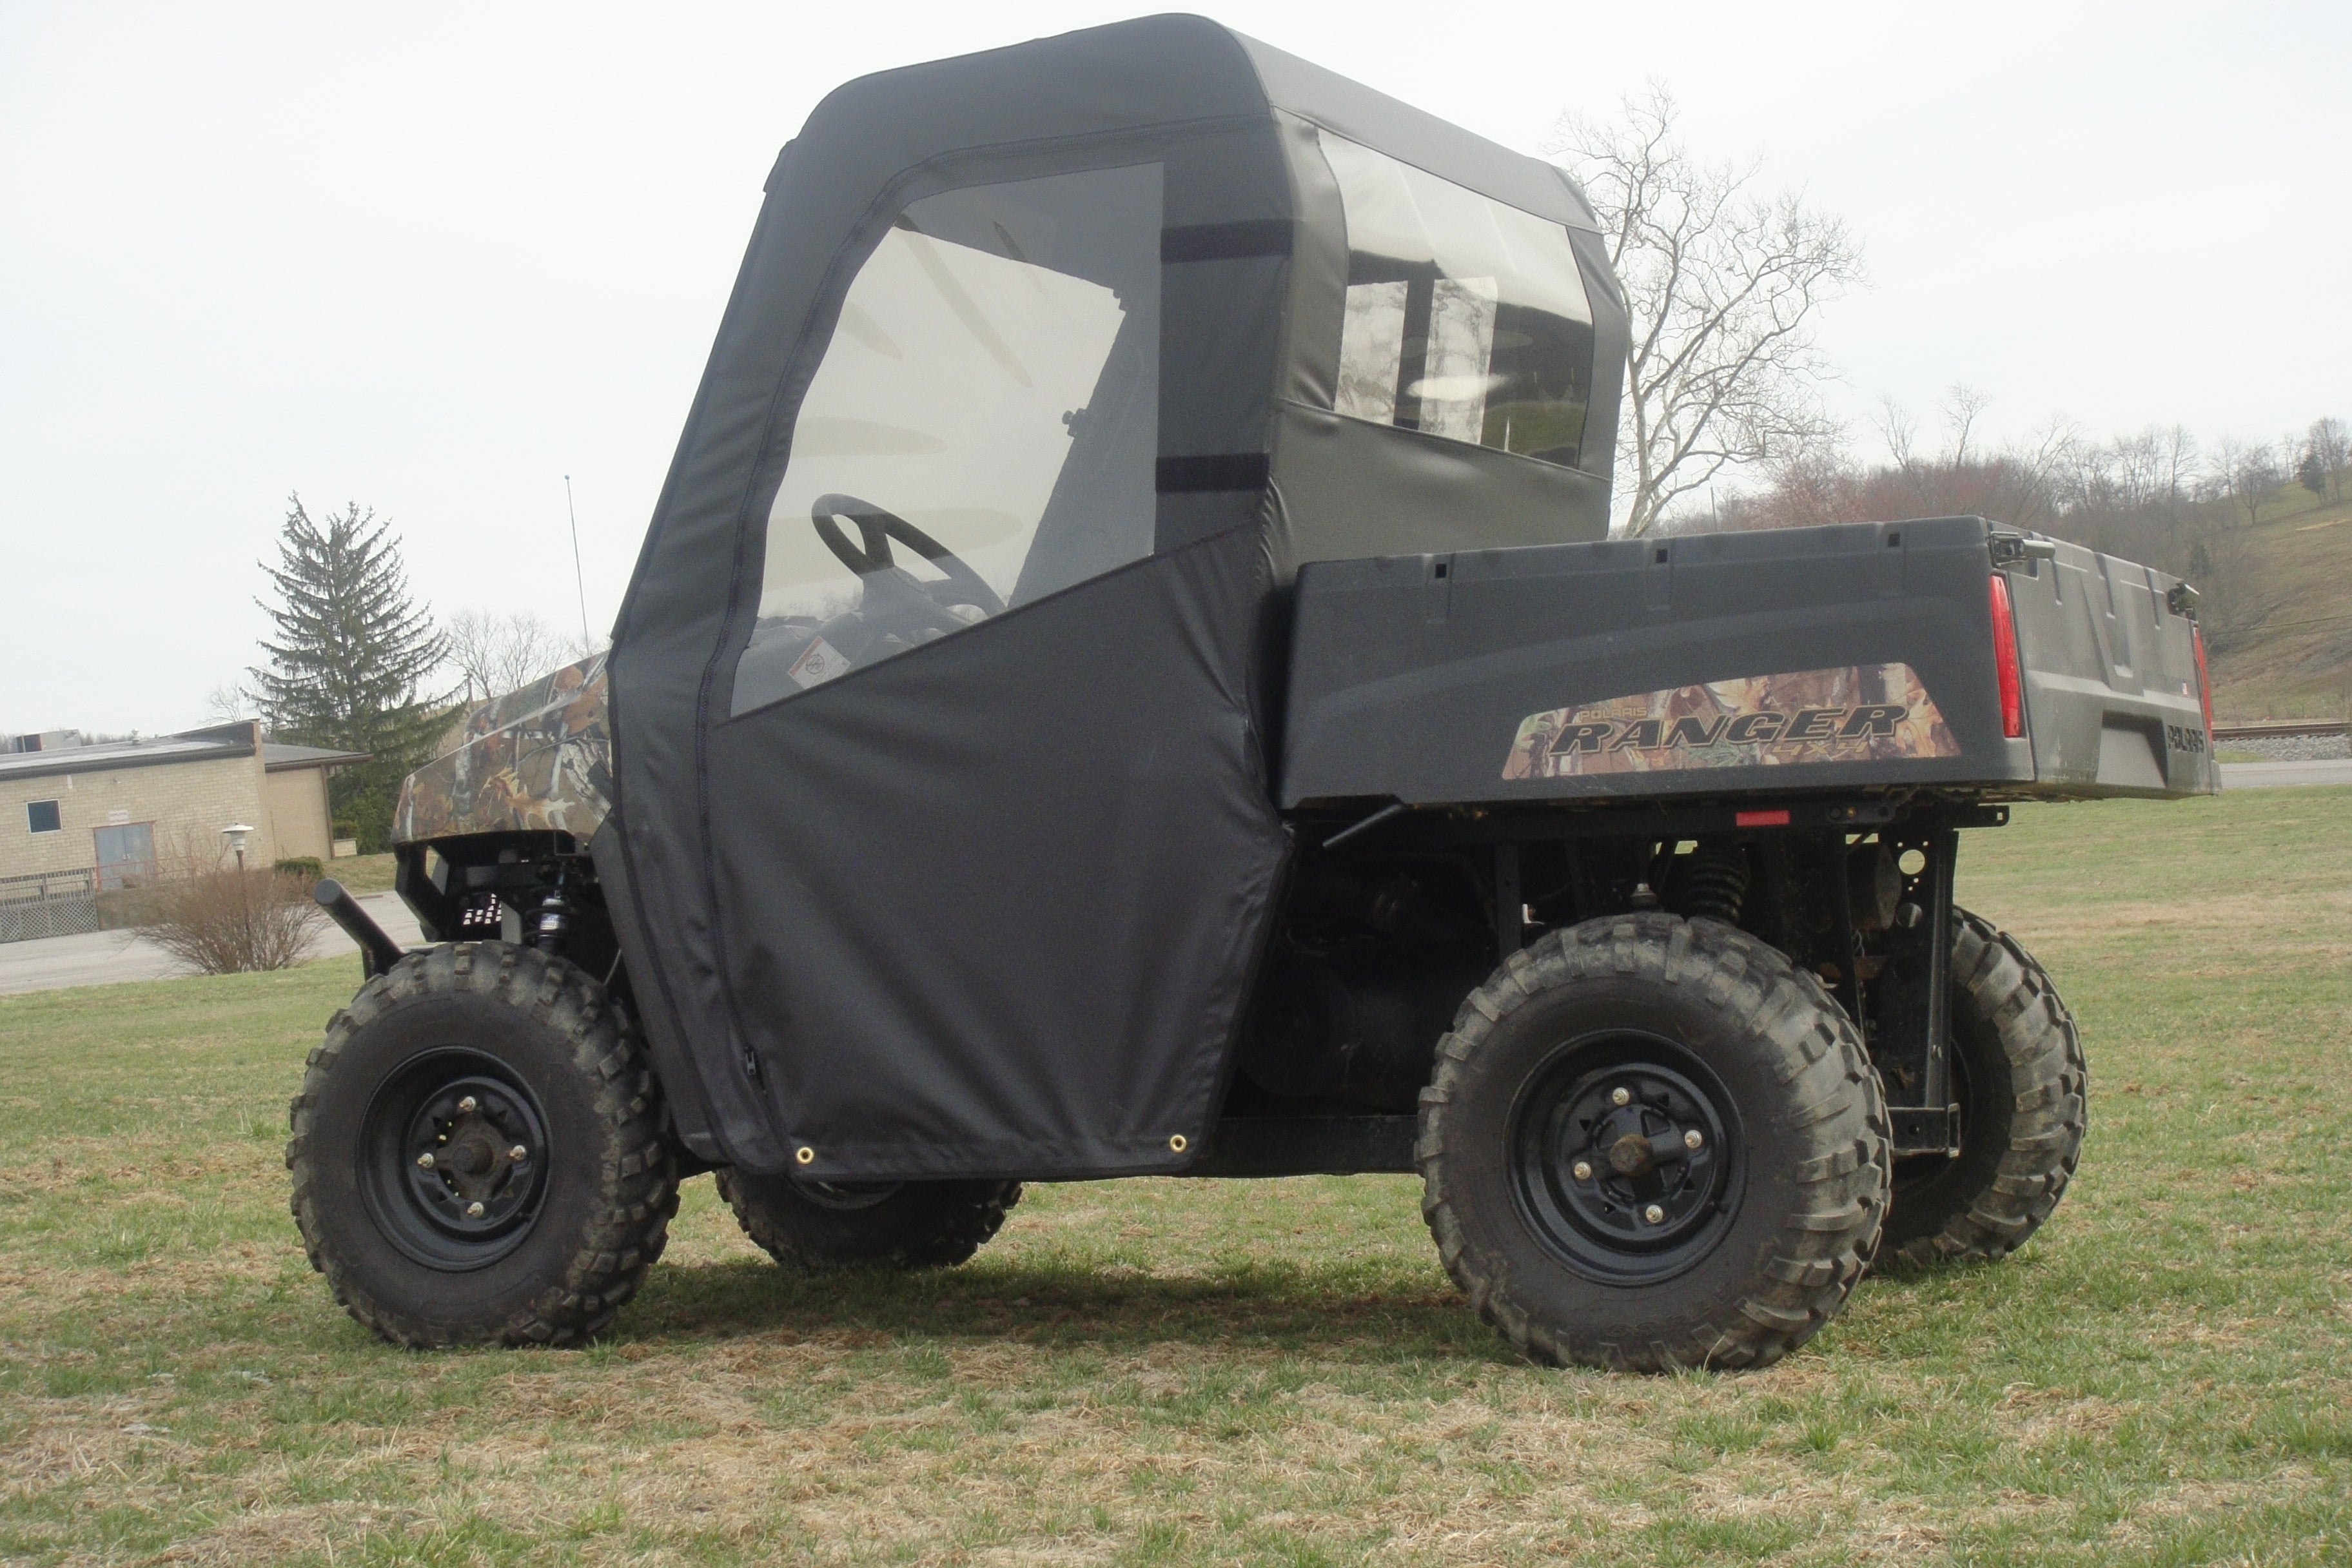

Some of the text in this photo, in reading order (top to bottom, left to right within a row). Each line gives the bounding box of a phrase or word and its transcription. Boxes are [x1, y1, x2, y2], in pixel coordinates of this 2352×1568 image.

[1580, 707, 1647, 723] POLARIS
[1548, 705, 1909, 756] RANGER
[2168, 725, 2204, 754] POLARIS
